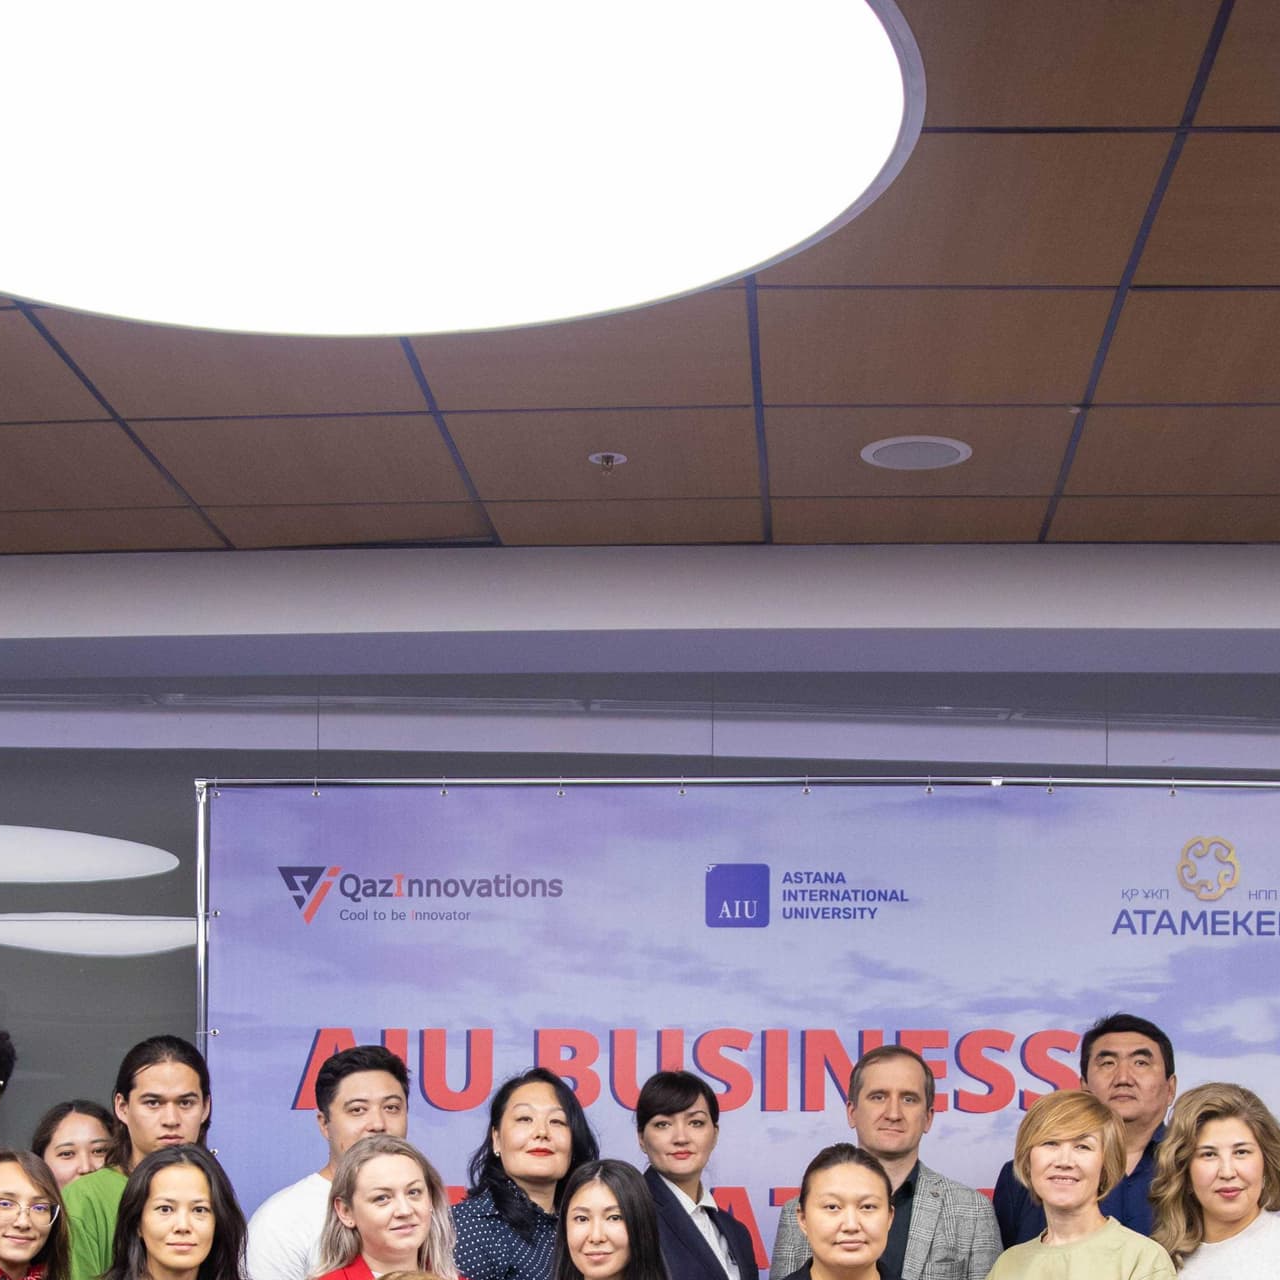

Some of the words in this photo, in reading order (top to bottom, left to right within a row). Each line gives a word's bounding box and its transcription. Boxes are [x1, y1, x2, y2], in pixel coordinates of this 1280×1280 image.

[782, 871, 846, 884] ASTANA
[339, 873, 563, 903] QazInnovations
[782, 889, 909, 902] INTERNATIONAL
[1248, 889, 1278, 901] НПП
[339, 909, 368, 921] Cool
[373, 910, 386, 921] to
[391, 909, 407, 921] be
[411, 909, 472, 921] Innovator
[718, 900, 758, 919] AIU
[782, 907, 878, 920] UNIVERSITY
